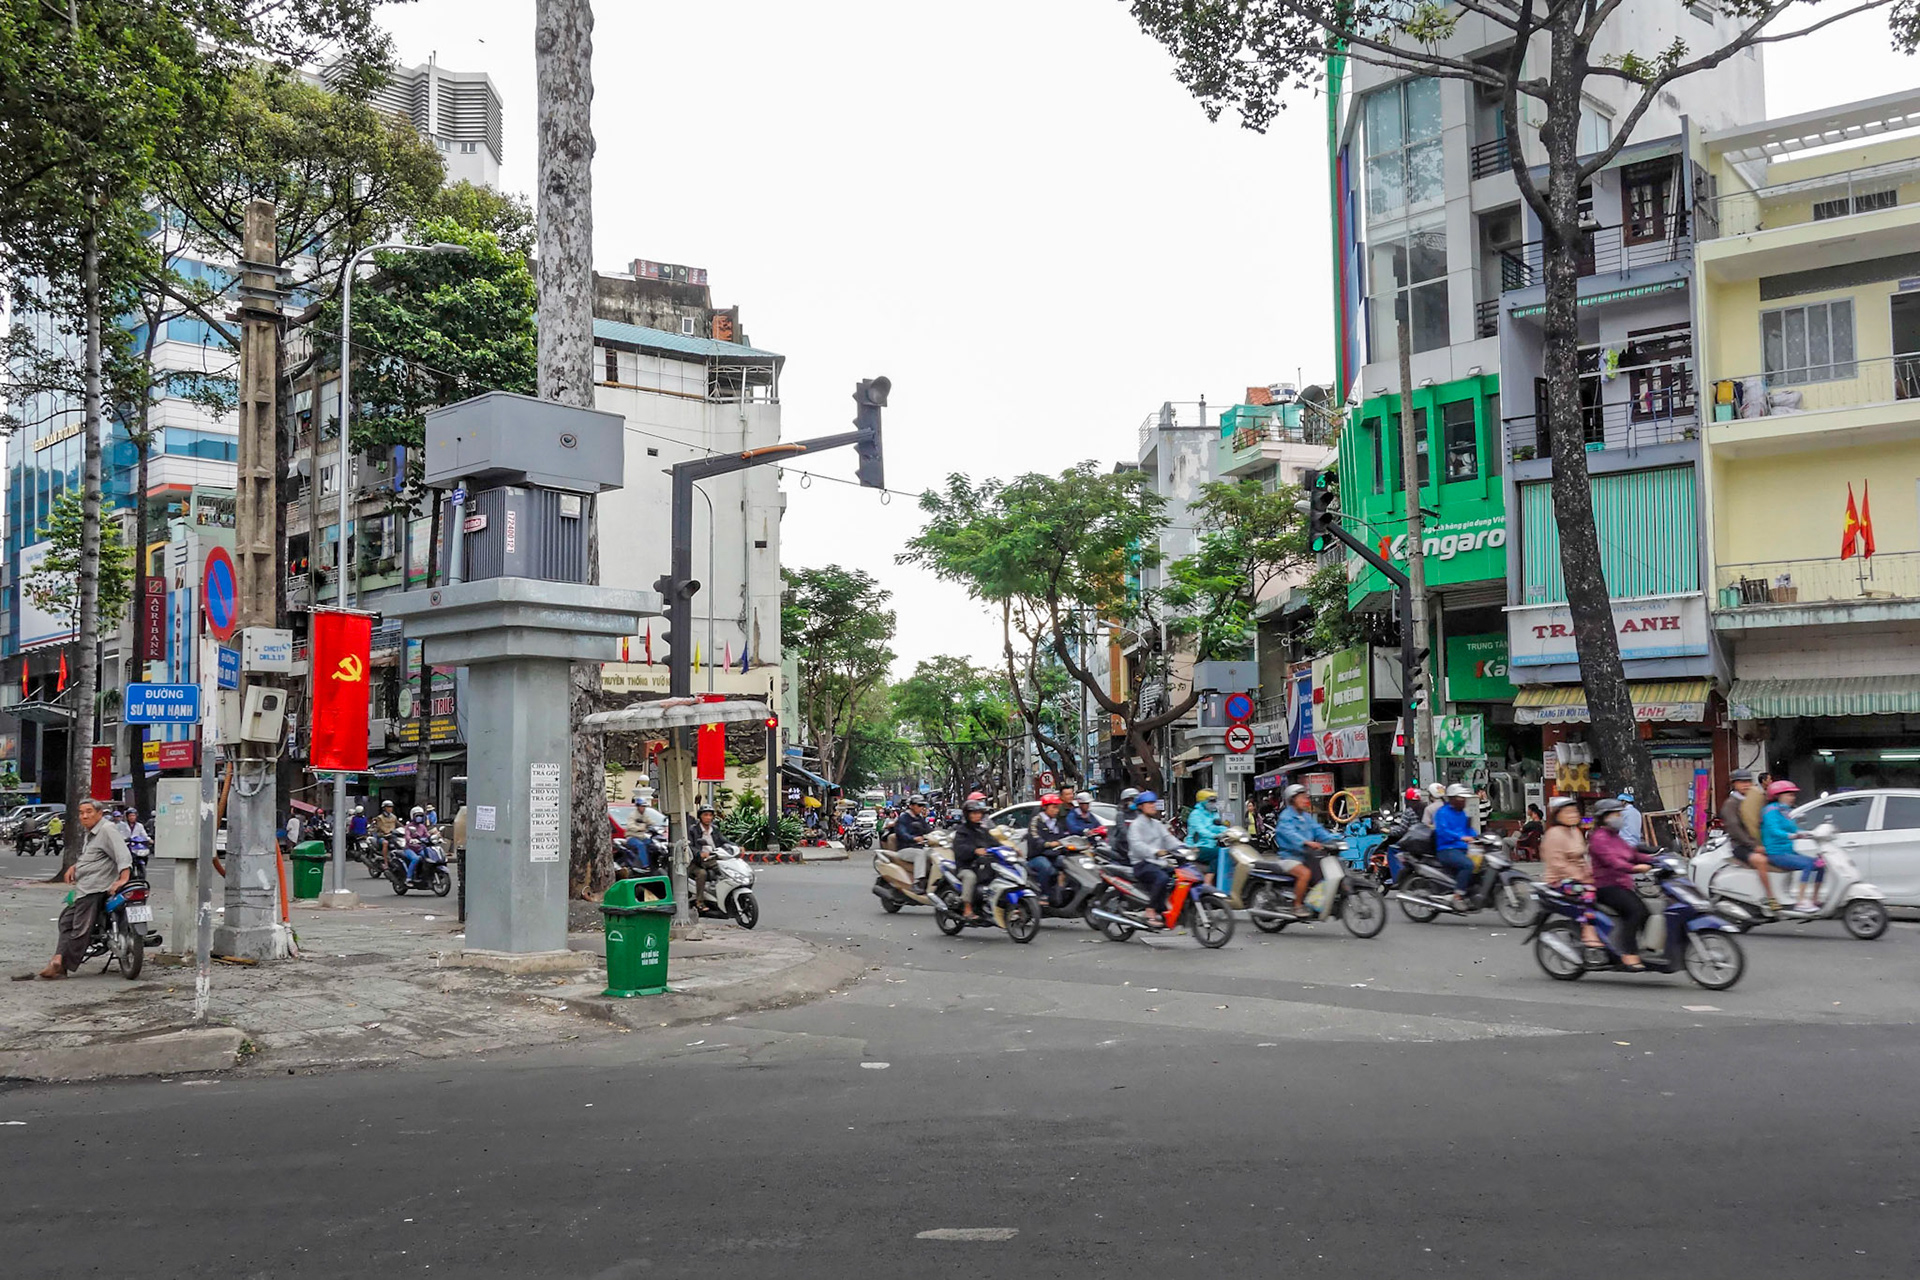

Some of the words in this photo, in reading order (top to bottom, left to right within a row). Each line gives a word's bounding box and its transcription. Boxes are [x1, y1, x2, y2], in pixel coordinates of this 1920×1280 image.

[1462, 519, 1474, 530] gia
[1378, 528, 1506, 561] Kngaro
[150, 598, 160, 656] AGRIBANK
[1620, 616, 1680, 634] ANH
[1467, 642, 1494, 650] TRUNG
[1474, 660, 1508, 678] Ka
[628, 674, 648, 686] THỐNG
[145, 687, 184, 699] ĐƯỜNG
[130, 702, 144, 716] SƯ
[146, 704, 165, 719] VẠN
[167, 704, 193, 719] HẠNH
[1636, 706, 1666, 717] ANH
